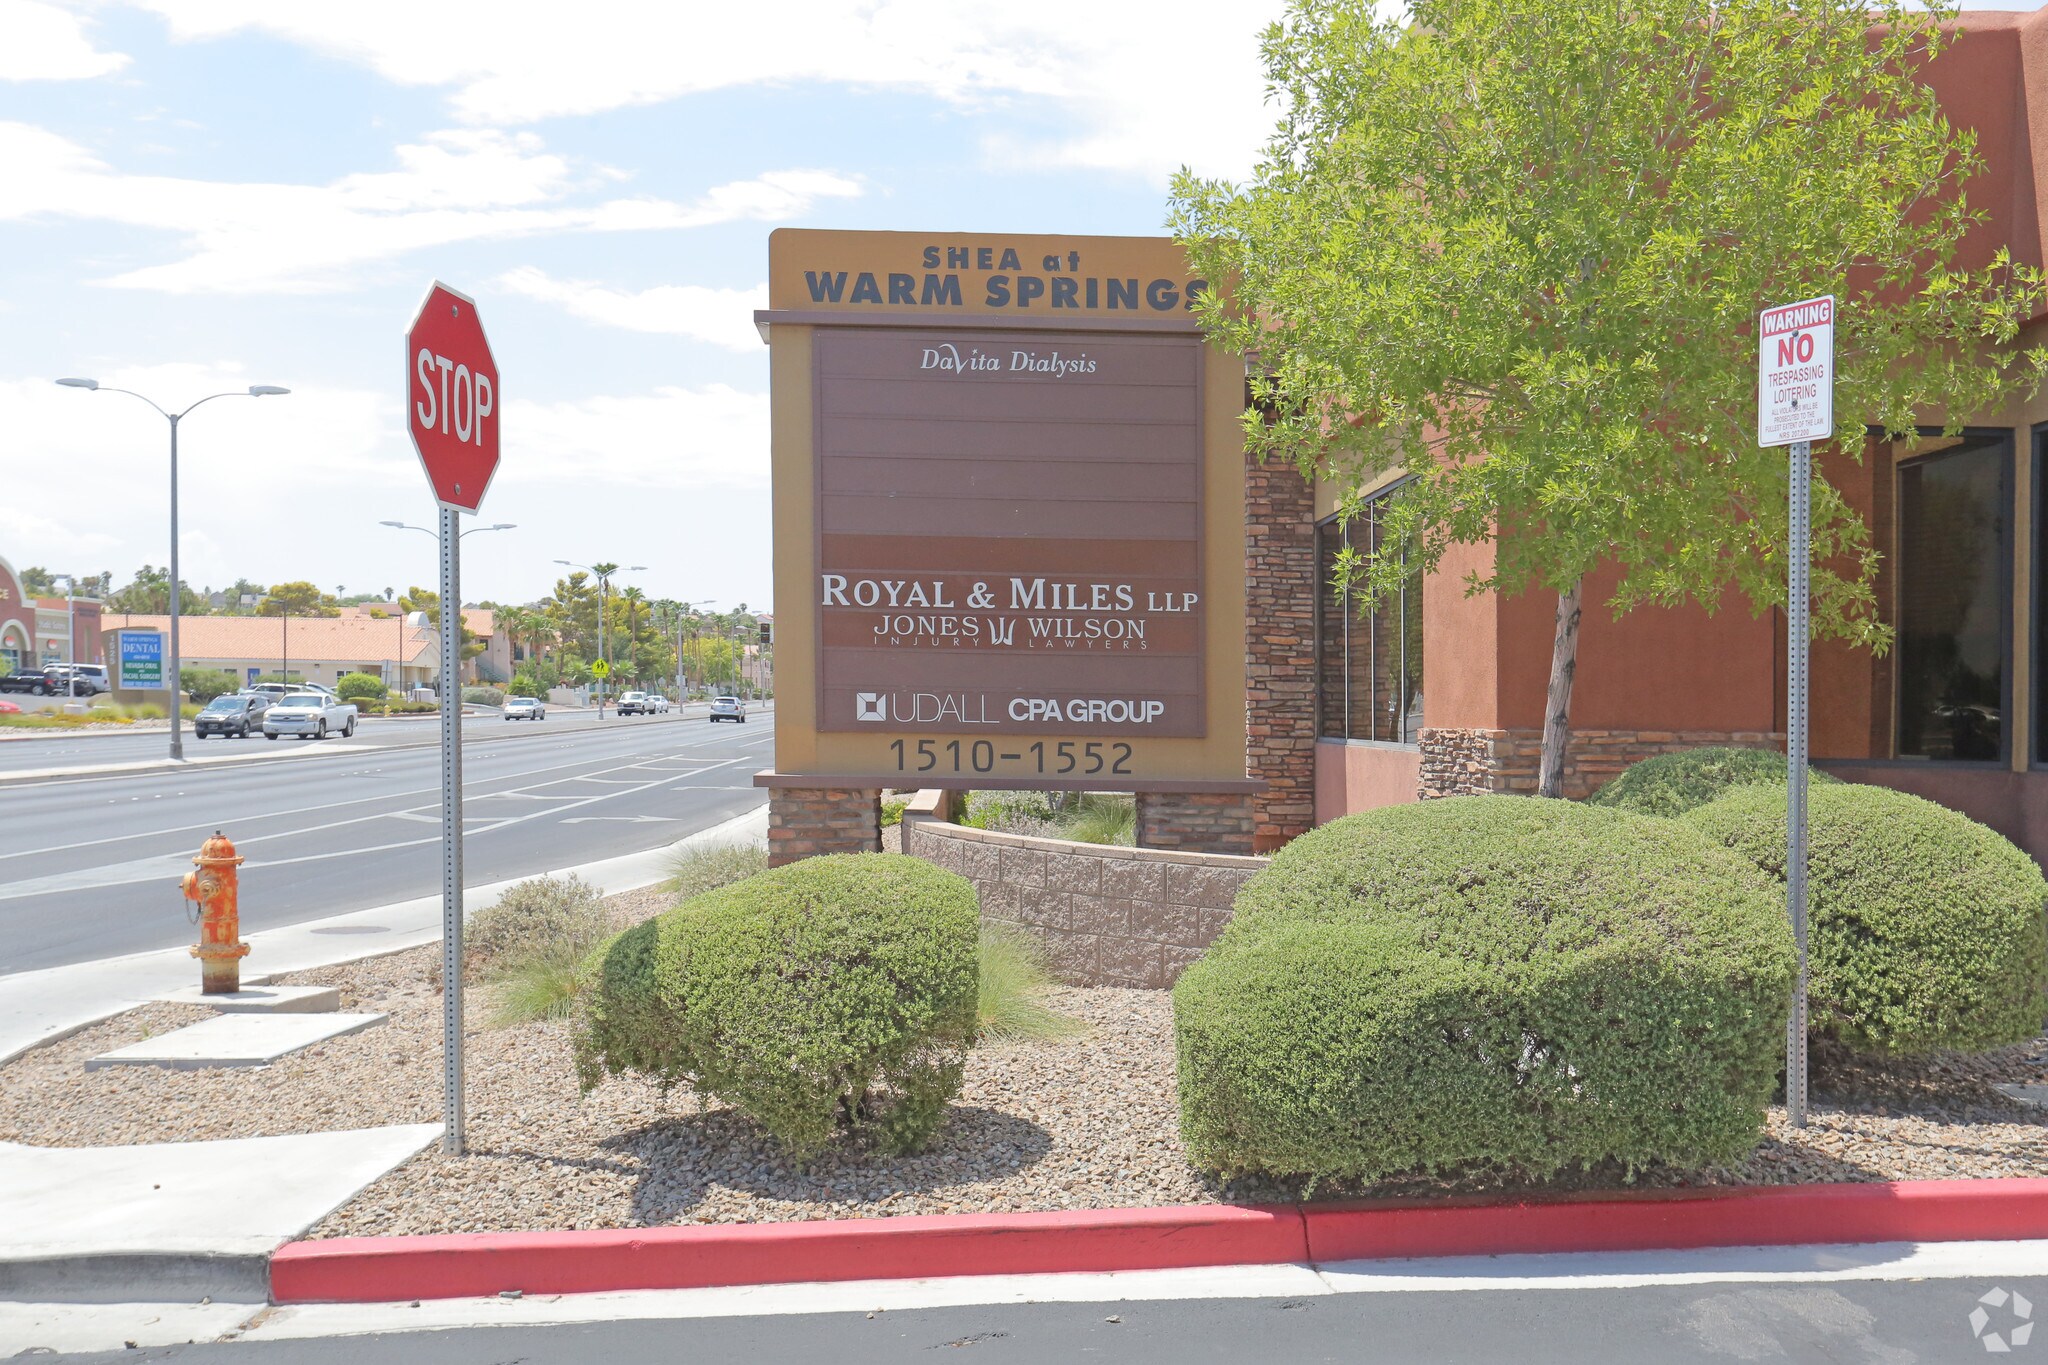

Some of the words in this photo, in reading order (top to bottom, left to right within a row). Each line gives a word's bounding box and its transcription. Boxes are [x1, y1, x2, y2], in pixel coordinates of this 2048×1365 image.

[922, 246, 1022, 271] SHEA
[1042, 250, 1080, 272] at
[803, 270, 963, 306] WARM
[1764, 302, 1830, 334] WARNING
[920, 343, 1001, 375] DaVita
[1009, 351, 1097, 378] Dialysis
[1778, 333, 1814, 368] NO
[1768, 364, 1824, 388] TRESPASSING
[417, 348, 492, 447] STOP
[1774, 383, 1817, 404] LOITERING
[821, 574, 955, 608] ROYAL
[966, 581, 996, 609] &
[1009, 577, 1134, 612] MILES
[1147, 592, 1199, 612] LLP
[873, 615, 980, 637] JONES
[1027, 617, 1146, 639] WILSON
[123, 643, 160, 653] DENTAL
[874, 636, 980, 647] INJURY
[1028, 639, 1147, 650] LAWYERS
[893, 693, 1000, 723] UDALL
[1008, 698, 1064, 722] CPA
[1066, 700, 1165, 723] GROUP
[889, 739, 1133, 774] 1510-1552
